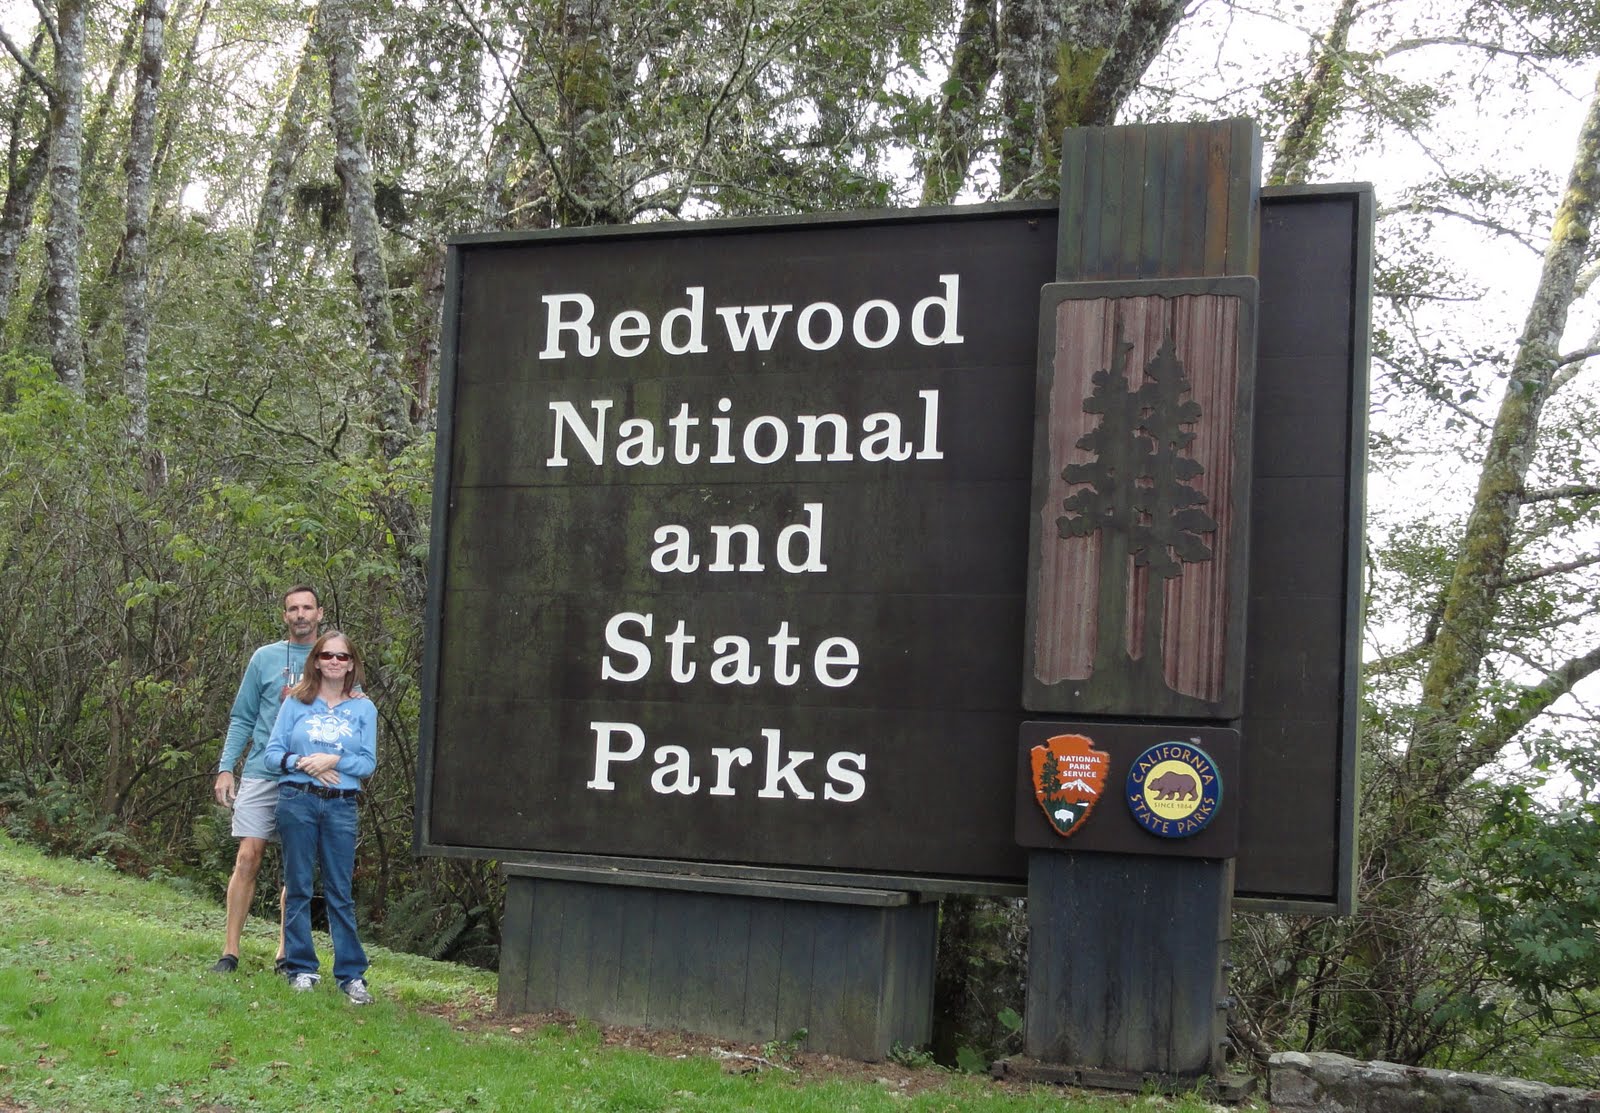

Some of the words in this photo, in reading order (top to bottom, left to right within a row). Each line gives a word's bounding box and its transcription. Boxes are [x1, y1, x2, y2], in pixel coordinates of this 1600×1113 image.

[538, 274, 964, 360] Redwood
[546, 390, 944, 468] National
[650, 503, 827, 574] and
[601, 612, 860, 687] State
[586, 722, 866, 803] Parks
[1059, 755, 1101, 763] NATIONAL
[1062, 770, 1097, 778] SERVICE
[1132, 747, 1214, 785] CALIFORNIA
[1130, 794, 1169, 833] STATE
[1177, 797, 1215, 833] PARKS
